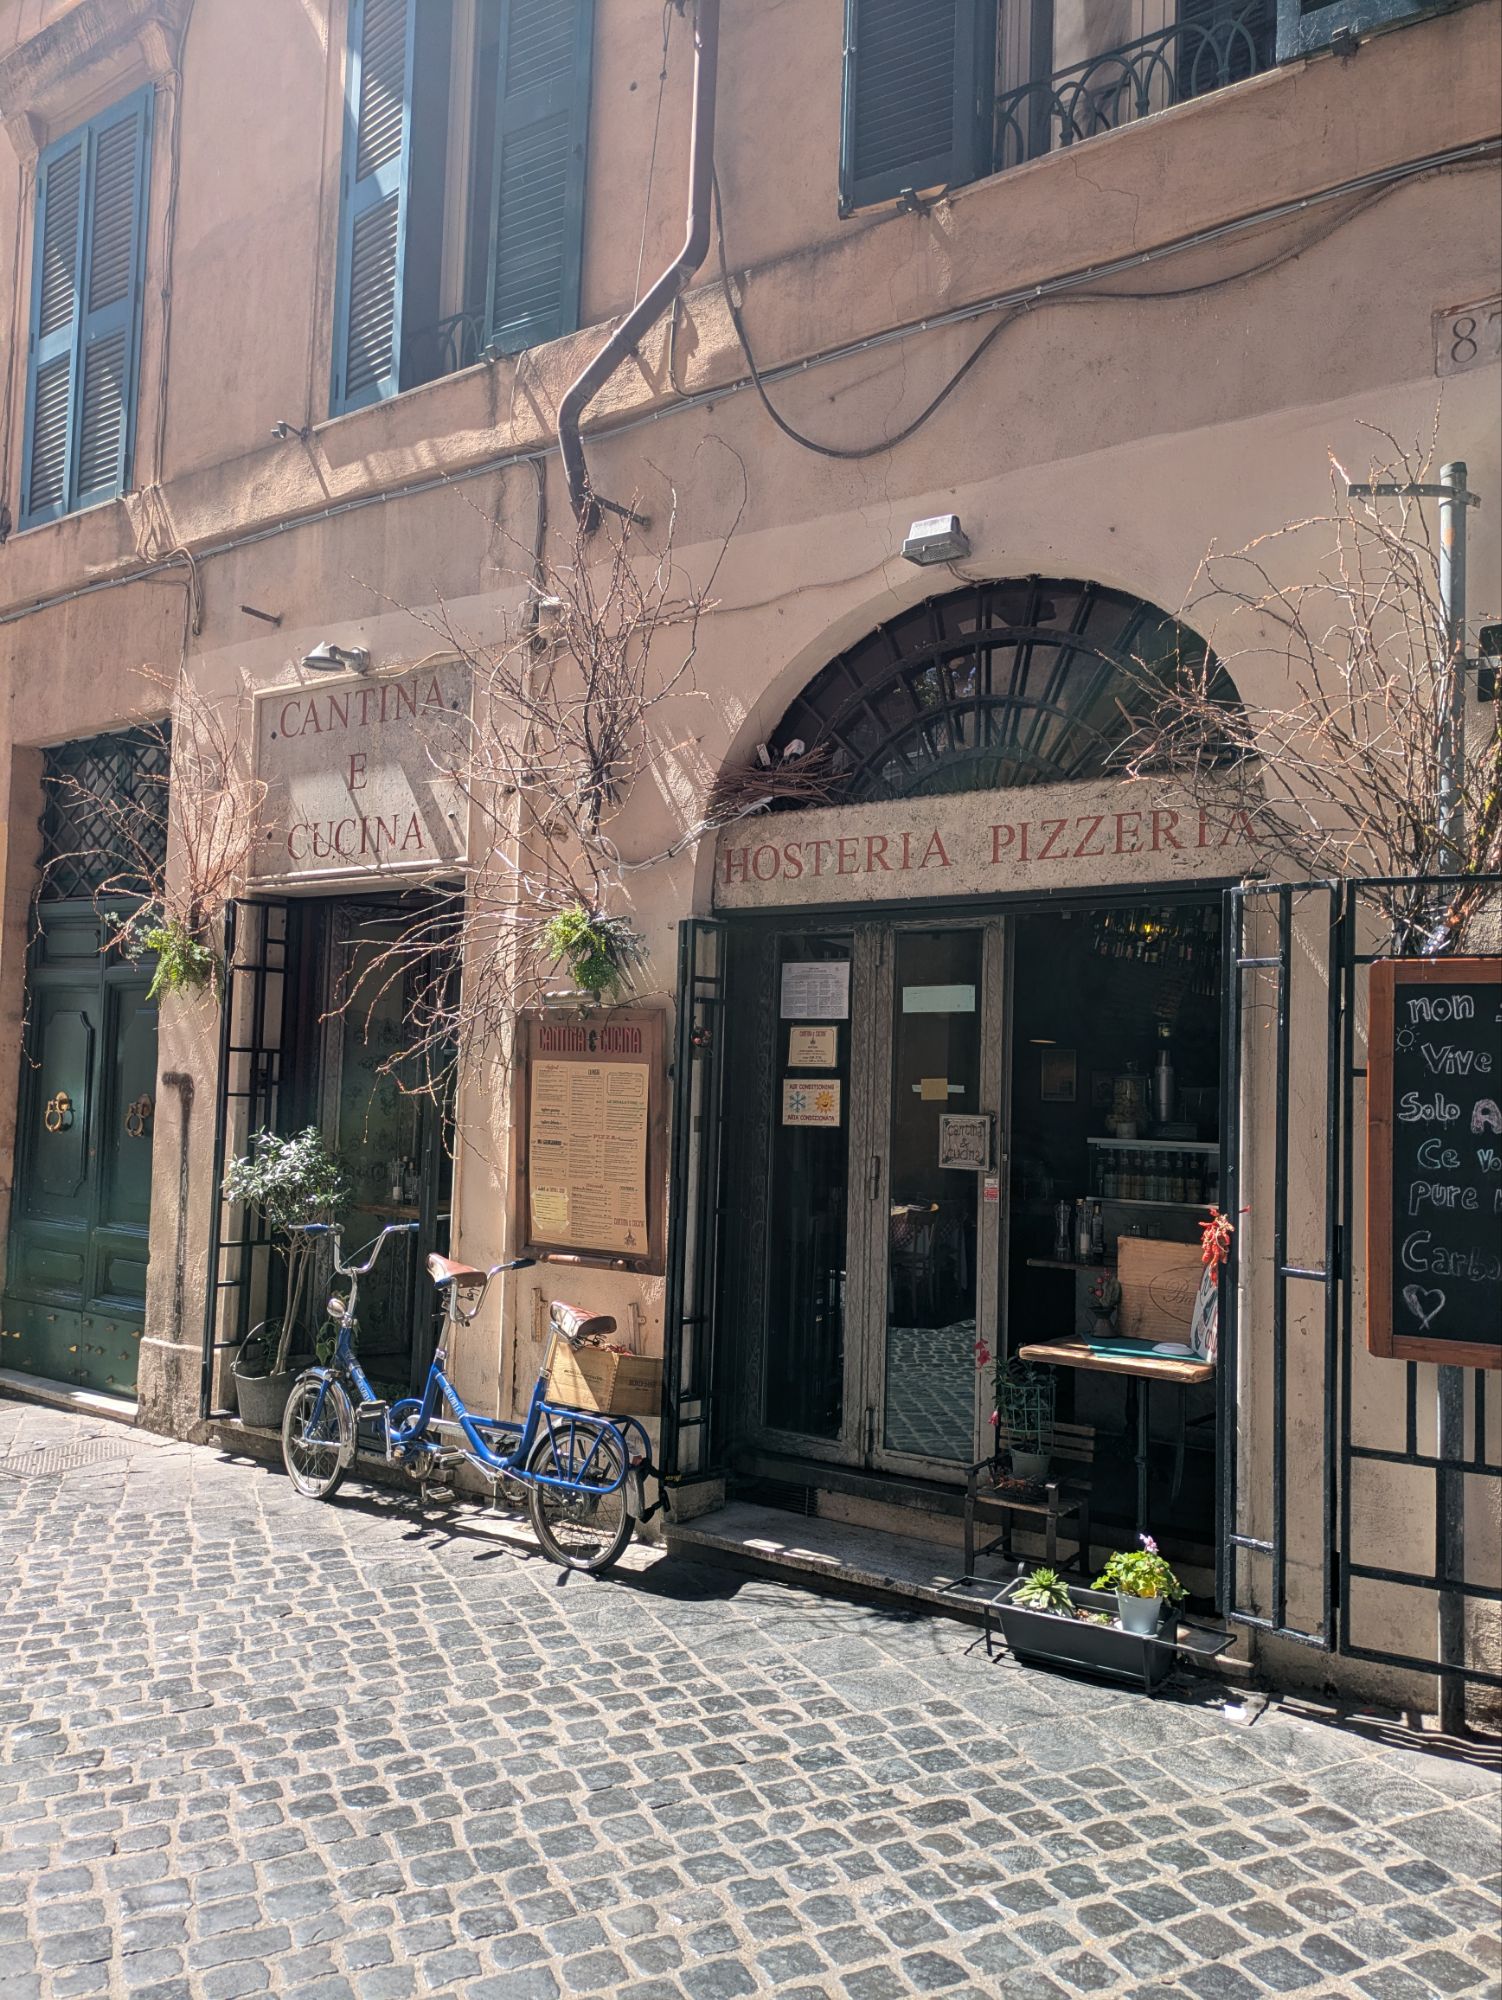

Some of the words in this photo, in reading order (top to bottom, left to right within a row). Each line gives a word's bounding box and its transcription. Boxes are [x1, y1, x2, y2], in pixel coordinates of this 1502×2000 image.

[280, 676, 446, 739] CANTINA
[346, 752, 368, 791] E
[287, 811, 427, 861] CUCINA
[721, 828, 952, 885] HOSTERIA
[989, 806, 1262, 865] PIZZERIA
[1406, 995, 1475, 1023] non
[539, 1025, 587, 1052] CANTINA
[600, 1026, 642, 1053] CUCINA
